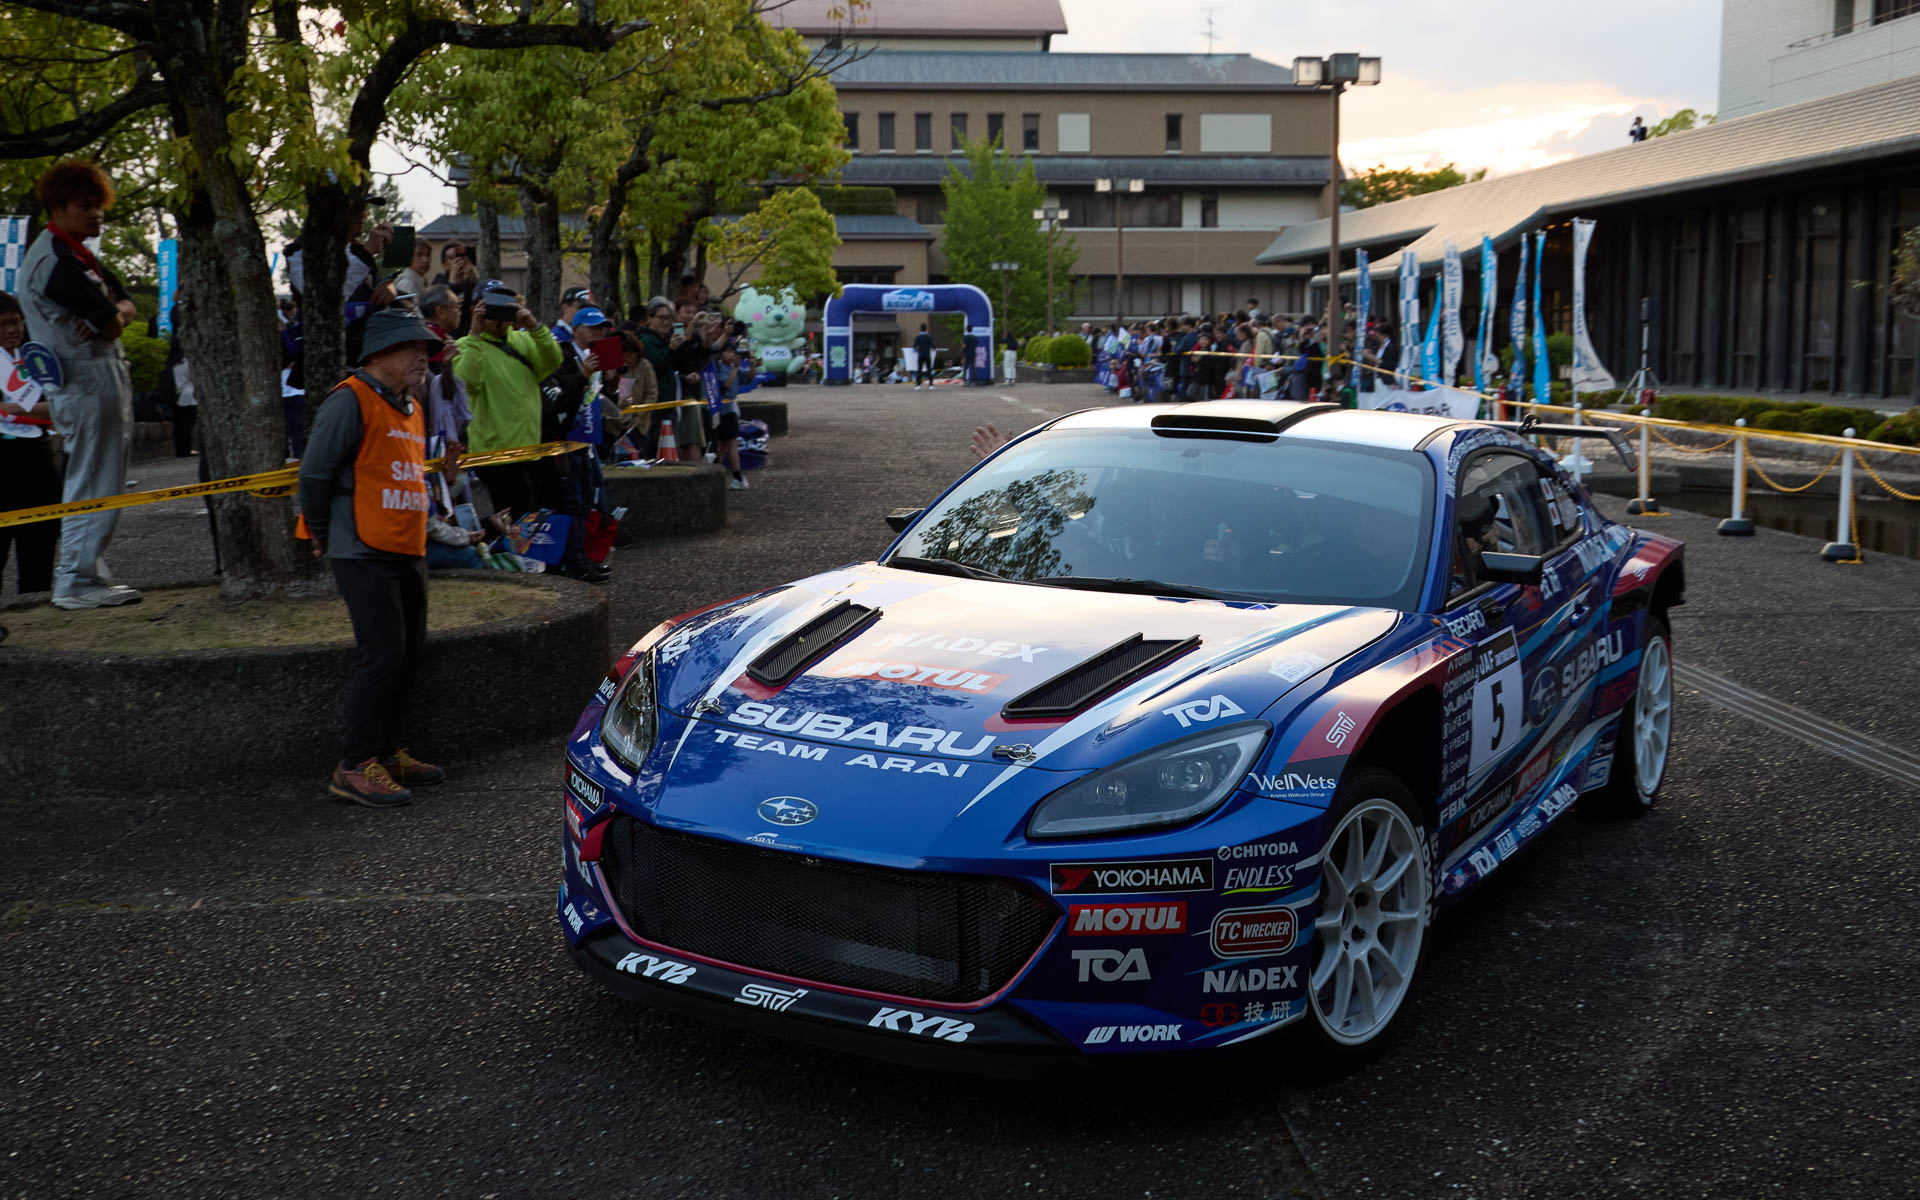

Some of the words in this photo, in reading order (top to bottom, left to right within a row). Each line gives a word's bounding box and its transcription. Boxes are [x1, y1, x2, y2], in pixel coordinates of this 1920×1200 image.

[169, 477, 251, 498] DUNLOP
[1446, 609, 1486, 638] RECARO
[874, 631, 1051, 663] NADEX
[843, 660, 996, 691] MOTUL
[1561, 629, 1623, 698] SUBARU
[1161, 694, 1246, 729] TOA
[1491, 680, 1505, 751] 5
[727, 700, 998, 758] SUBARU
[713, 729, 831, 762] TEAM
[844, 751, 971, 779] ARAI
[570, 769, 601, 808] YOKOHAMA
[1248, 772, 1338, 791] WellNets
[1440, 795, 1468, 828] FBK
[1232, 841, 1299, 859] CHIYODA
[1093, 866, 1205, 888] YOKOHAMA
[1223, 863, 1296, 889] ENDLESS
[1074, 906, 1182, 931] MOTUL
[1219, 921, 1242, 942] TC
[1242, 920, 1291, 939] WRECKER
[616, 951, 697, 985] KYB
[1071, 947, 1152, 983] TOA
[1203, 965, 1299, 993] NADEX
[868, 1006, 976, 1043] KYB
[1120, 1024, 1184, 1043] WORK
